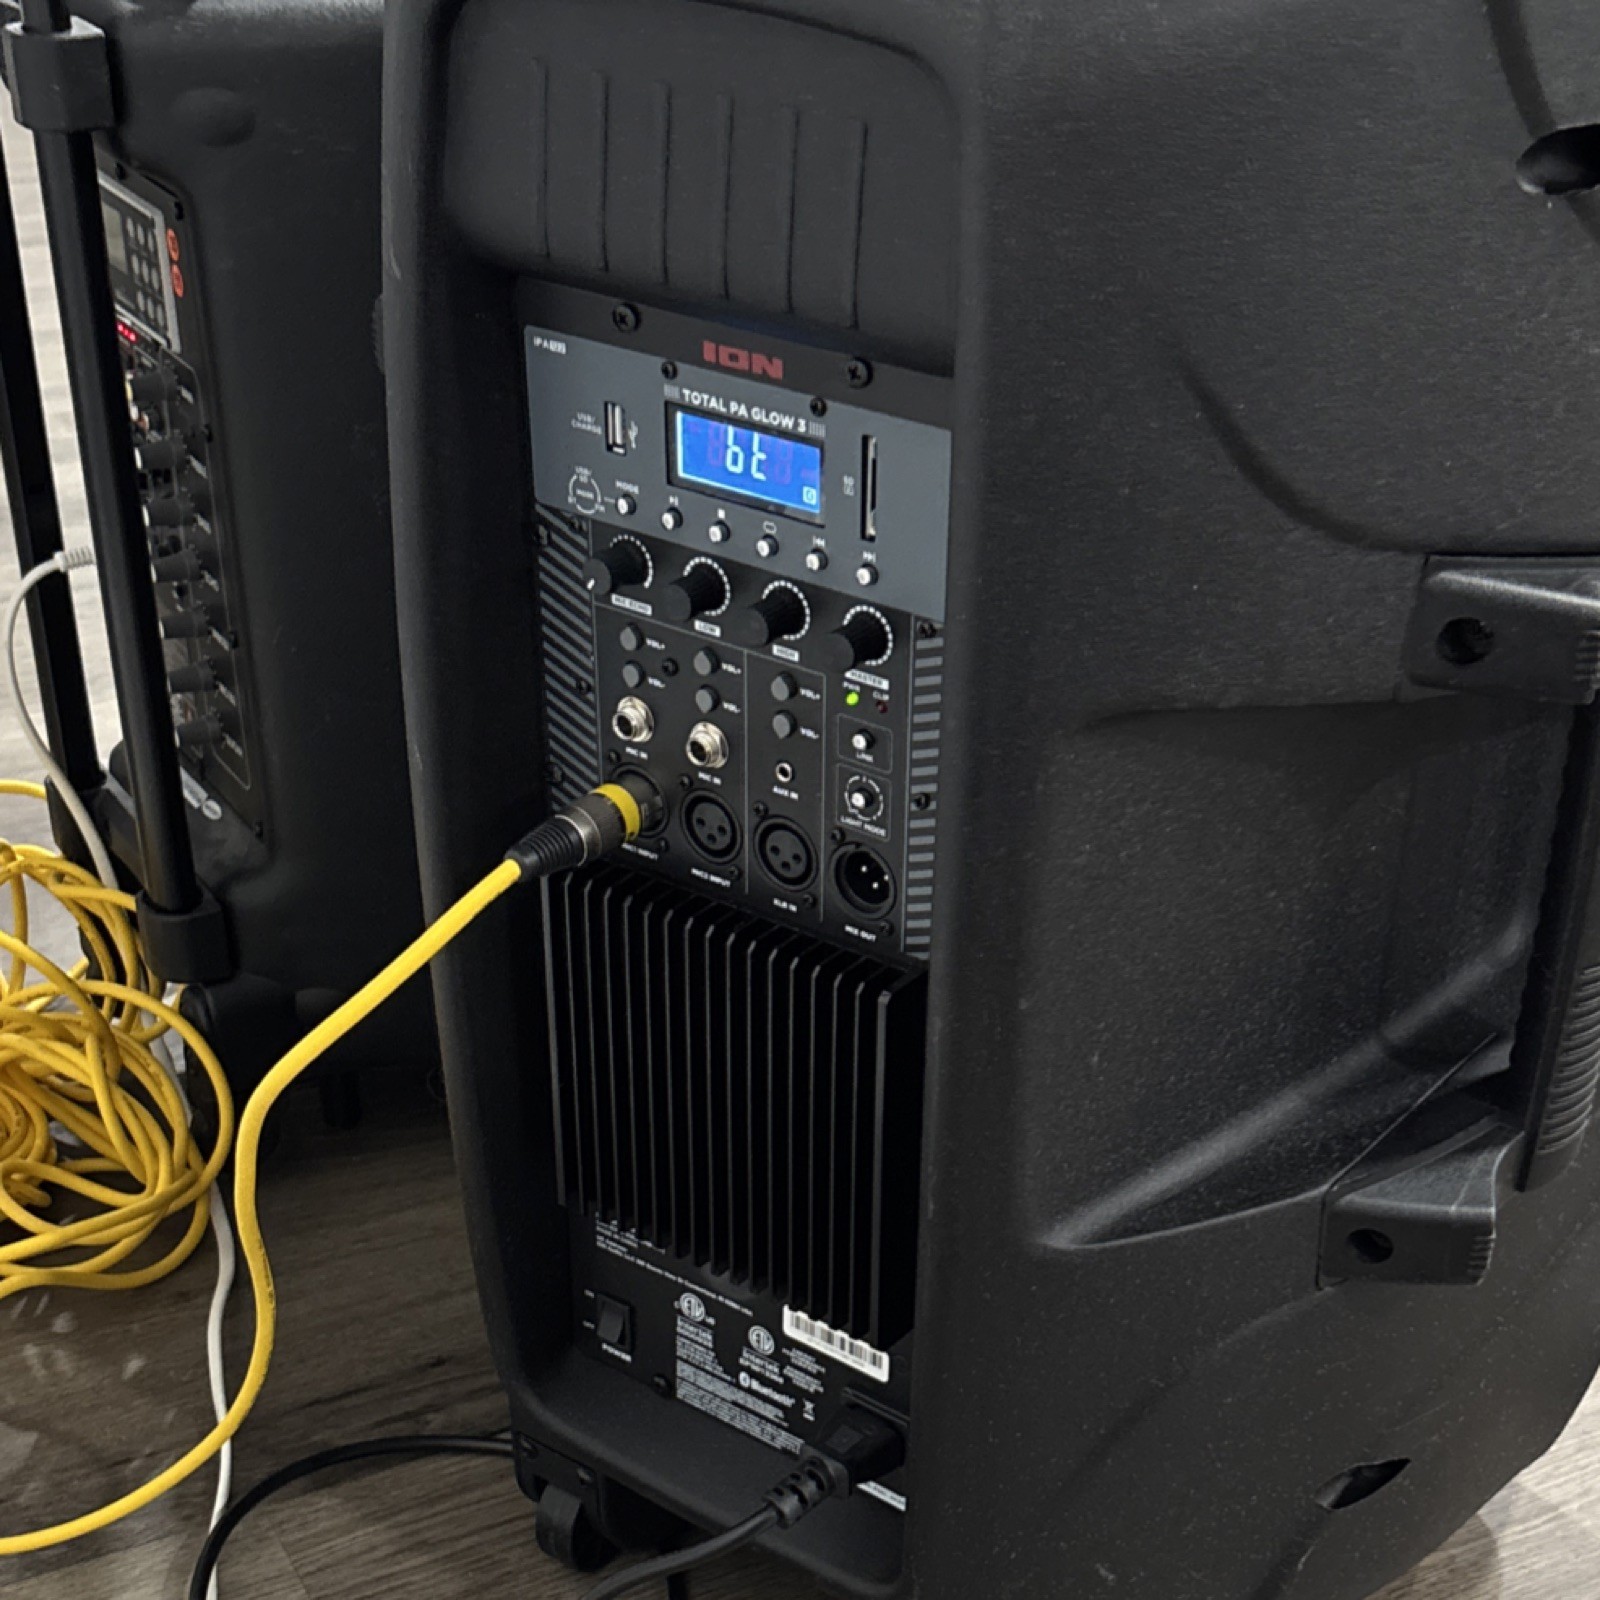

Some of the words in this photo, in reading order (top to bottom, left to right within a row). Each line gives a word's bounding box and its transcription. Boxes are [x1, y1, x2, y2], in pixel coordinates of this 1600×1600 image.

[702, 340, 784, 381] ION
[682, 387, 728, 413] TOTAL
[729, 400, 749, 419] PA
[750, 406, 796, 430] GLOW
[797, 418, 807, 433] 3
[849, 670, 885, 687] MASTER
